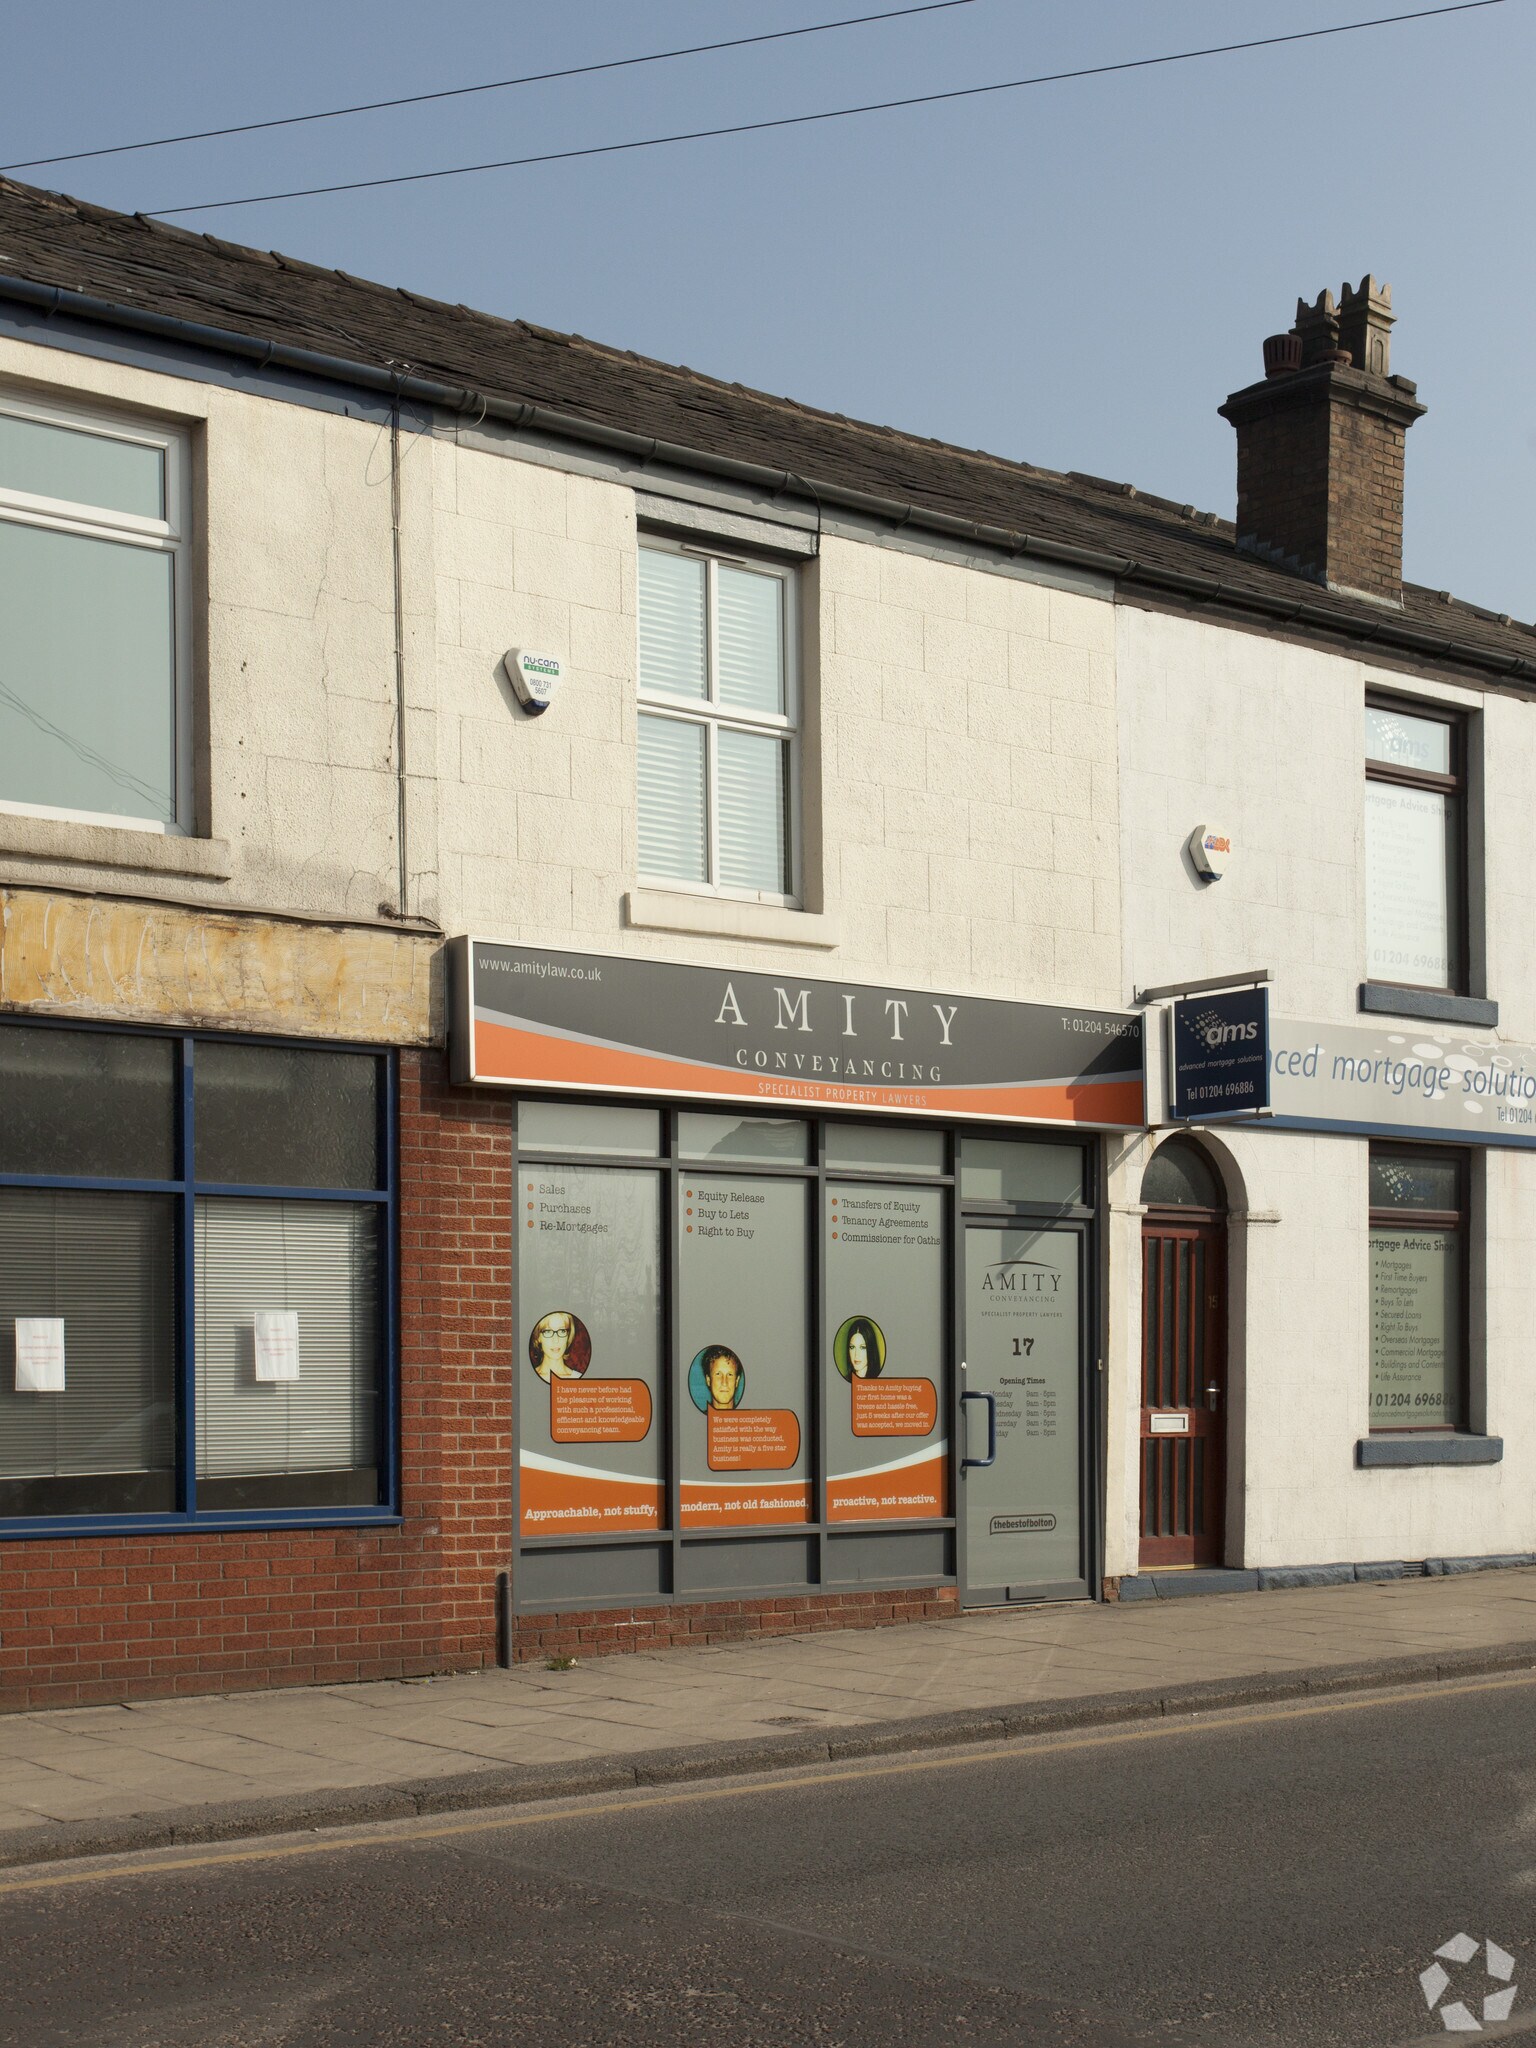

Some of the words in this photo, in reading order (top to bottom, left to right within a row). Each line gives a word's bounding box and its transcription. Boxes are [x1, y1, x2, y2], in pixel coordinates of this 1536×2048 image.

[527, 665, 555, 674] SYSTEMS
[1373, 949, 1409, 966] 01204
[479, 957, 602, 982] www.amitylaw.co.uk
[715, 982, 958, 1045] AMITY
[1073, 1019, 1102, 1033] 01204
[1104, 1023, 1139, 1037] 546570
[1206, 1022, 1258, 1045] ams
[736, 1049, 941, 1082] CONVEYANCING
[1178, 1061, 1205, 1071] advanced
[1207, 1059, 1235, 1068] mortgage
[1237, 1054, 1262, 1063] solutions
[1332, 1053, 1450, 1097] mortgage
[758, 1082, 820, 1098] SPECIALIST
[826, 1088, 877, 1103] PROPERTY
[882, 1092, 927, 1106] LAWYERS
[1187, 1087, 1197, 1100] Tel
[1200, 1084, 1222, 1099] 01204
[1225, 1081, 1254, 1096] 696886
[1497, 1106, 1507, 1121] Tel
[1509, 1107, 1532, 1123] 01204
[539, 1184, 565, 1194] Sales
[698, 1190, 728, 1203] Equity
[730, 1192, 764, 1203] Release
[540, 1203, 591, 1214] Purchases
[841, 1198, 882, 1209] Transfers
[883, 1201, 891, 1209] of
[893, 1201, 920, 1213] Equity
[698, 1208, 716, 1220] Buy
[718, 1210, 727, 1218] to
[730, 1210, 749, 1219] Lets
[540, 1220, 608, 1234] Re-Mortgages
[841, 1215, 877, 1228] Tenancy
[879, 1218, 928, 1228] Agreements
[698, 1226, 722, 1237] Right
[725, 1228, 734, 1236] to
[736, 1228, 754, 1239] Buy
[841, 1232, 901, 1243] Commissioner
[903, 1235, 915, 1244] for
[917, 1235, 940, 1245] Oaths
[1403, 1238, 1431, 1250] Advice
[1380, 1260, 1411, 1271] Mortgages
[982, 1272, 1062, 1291] AMITY
[1380, 1271, 1392, 1281] First
[1394, 1272, 1407, 1281] Time
[1408, 1272, 1427, 1284] Buyers
[1380, 1284, 1418, 1296] Remortgages
[989, 1295, 1055, 1303] CONVEYANCING
[1380, 1297, 1394, 1308] Buys
[1396, 1297, 1402, 1306] To
[1380, 1310, 1404, 1319] Secured
[1405, 1311, 1421, 1319] Loans
[1380, 1322, 1395, 1333] Right
[1397, 1322, 1403, 1331] To
[1404, 1323, 1418, 1333] Buys
[1380, 1334, 1408, 1344] Overseas
[1409, 1335, 1440, 1346] Mortgages
[1012, 1338, 1035, 1356] 17
[1380, 1347, 1415, 1356] Commercial
[1380, 1360, 1406, 1370] Buildings
[999, 1377, 1025, 1385] Opening
[1380, 1371, 1390, 1381] Life
[1392, 1373, 1421, 1381] Assurance
[885, 1384, 902, 1392] Amity
[569, 1396, 596, 1404] pleasure
[605, 1396, 632, 1404] working
[1376, 1393, 1411, 1407] 01204
[595, 1406, 635, 1414] professional,
[856, 1412, 868, 1420] just
[598, 1416, 644, 1424] knowledgeable
[739, 1416, 771, 1424] completely
[713, 1445, 732, 1453] Amity
[739, 1445, 756, 1453] really
[680, 1500, 722, 1513] modern,
[724, 1500, 741, 1510] not
[742, 1499, 758, 1509] old
[832, 1495, 880, 1508] proactive,
[881, 1495, 896, 1505] not
[898, 1494, 937, 1504] reactive.
[525, 1507, 601, 1520] Approachable,
[603, 1506, 622, 1516] not
[623, 1504, 657, 1517] stuffy,
[993, 1518, 1053, 1529] thebestofbolton
